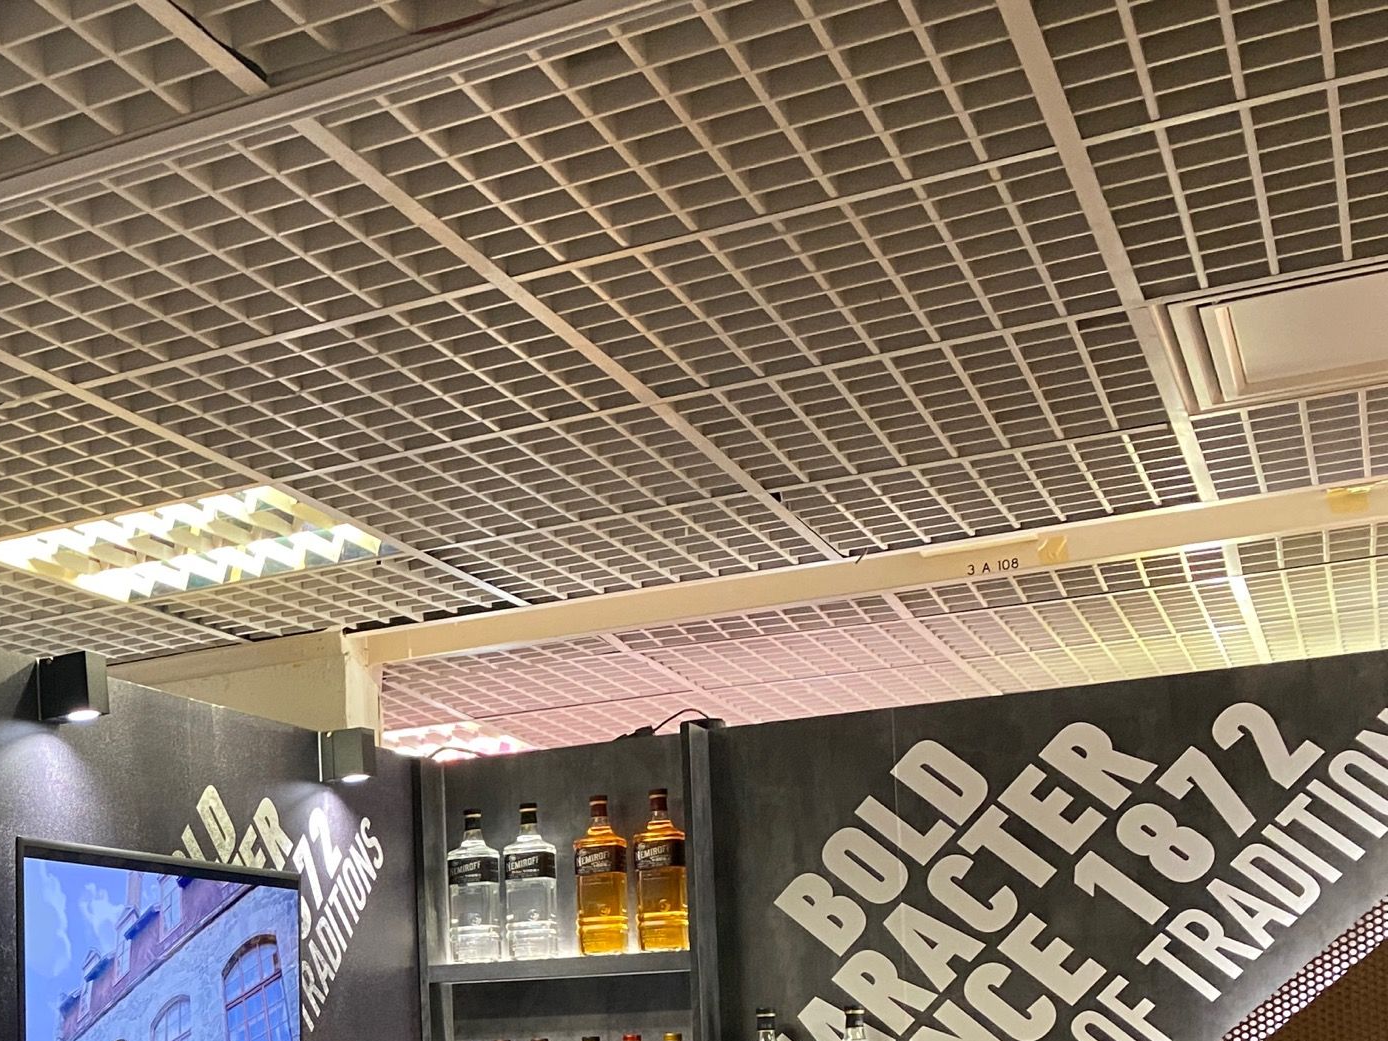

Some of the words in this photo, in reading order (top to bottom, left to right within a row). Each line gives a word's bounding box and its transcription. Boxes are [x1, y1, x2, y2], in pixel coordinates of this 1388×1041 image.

[967, 565, 975, 576] 3
[982, 563, 990, 573] A
[998, 558, 1019, 571] 108
[774, 739, 989, 957] BOLD
[1074, 702, 1326, 926] 1872
